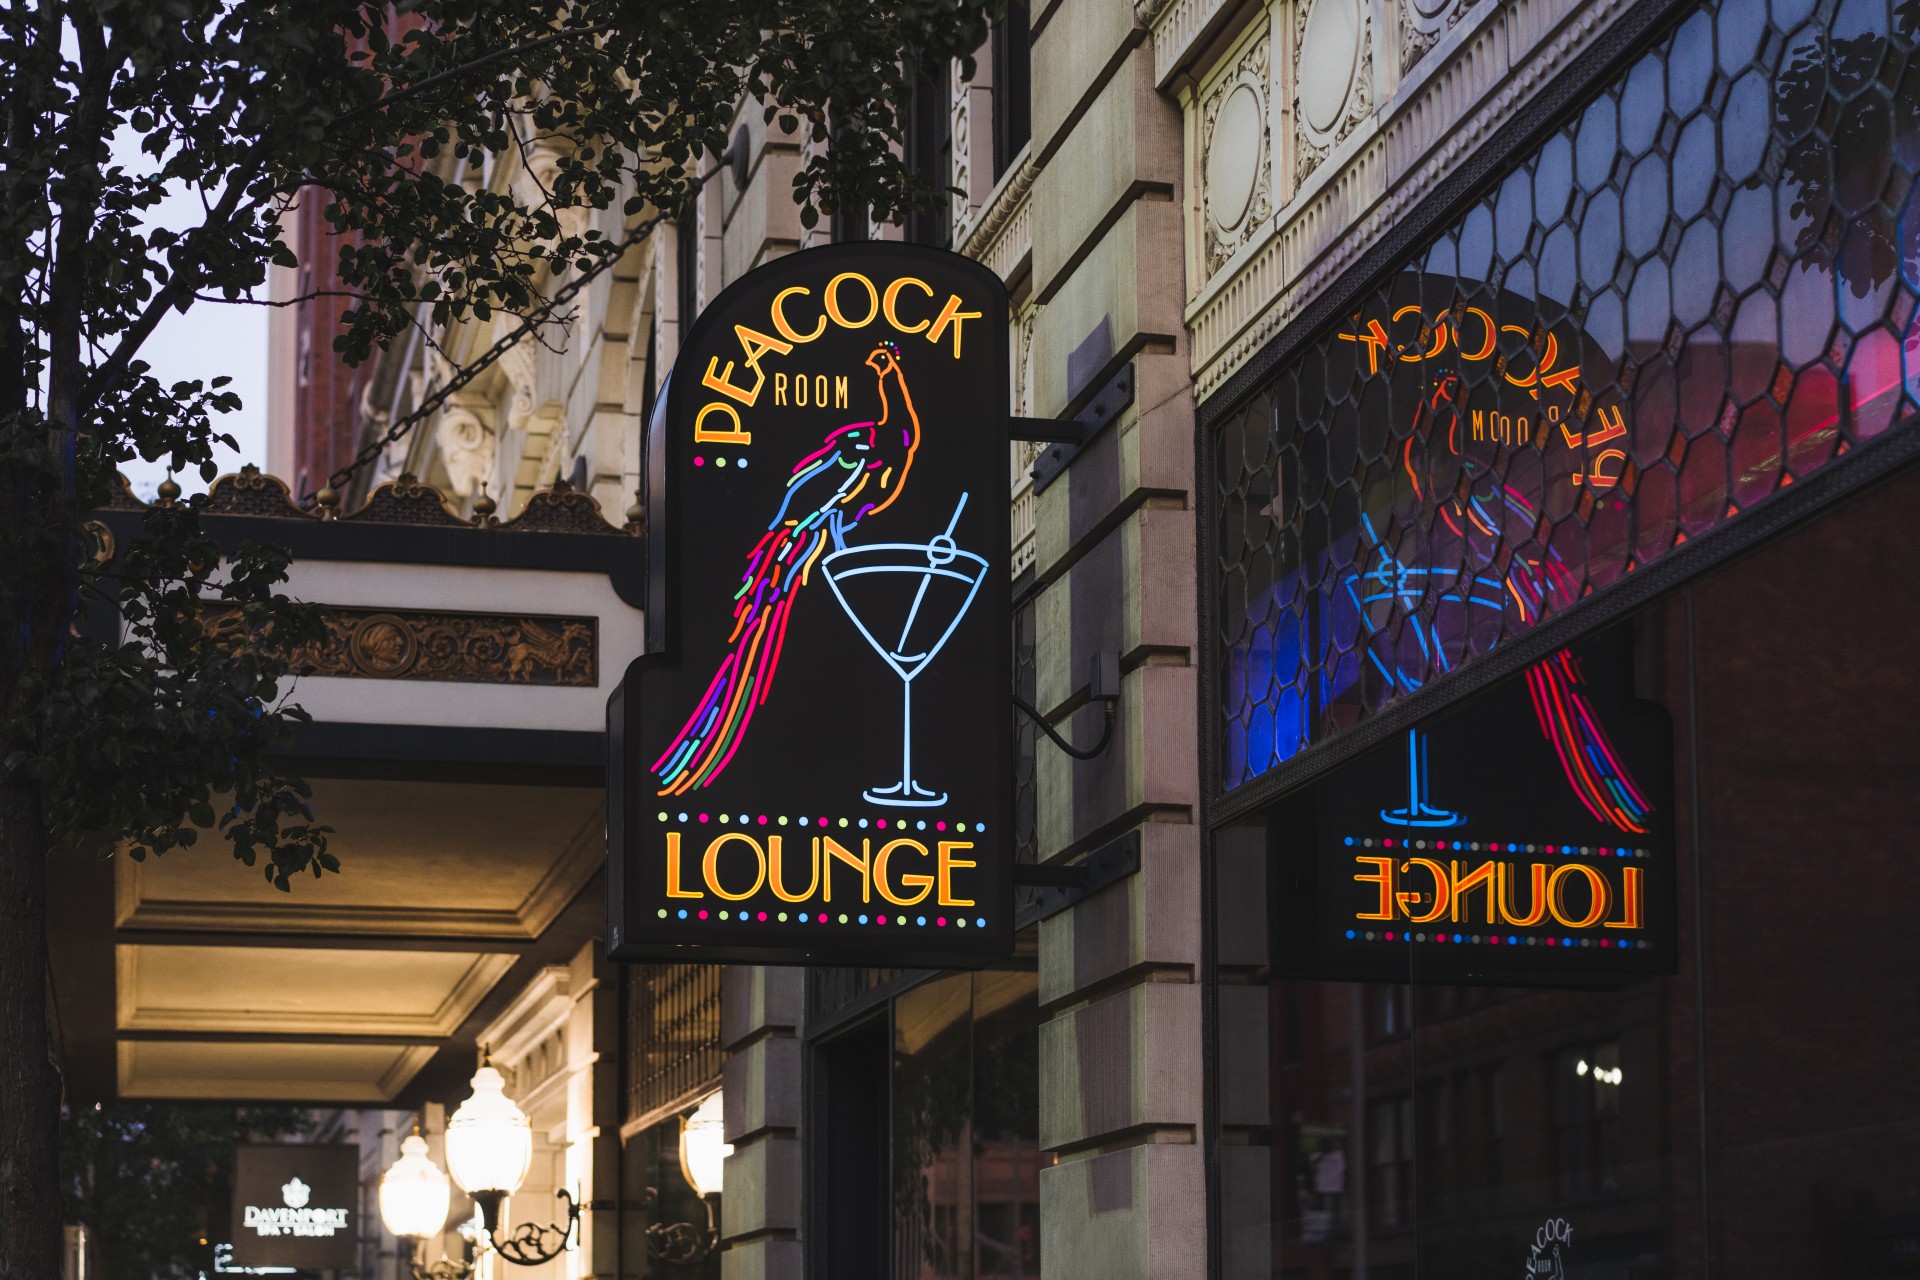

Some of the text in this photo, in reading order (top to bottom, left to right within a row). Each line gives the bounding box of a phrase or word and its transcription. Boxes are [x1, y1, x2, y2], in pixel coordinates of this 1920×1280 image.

[693, 271, 983, 446] PEACOCK
[774, 372, 848, 410] ROOM
[666, 831, 977, 907] LOUNGE
[244, 1206, 349, 1223] DAVENPORT
